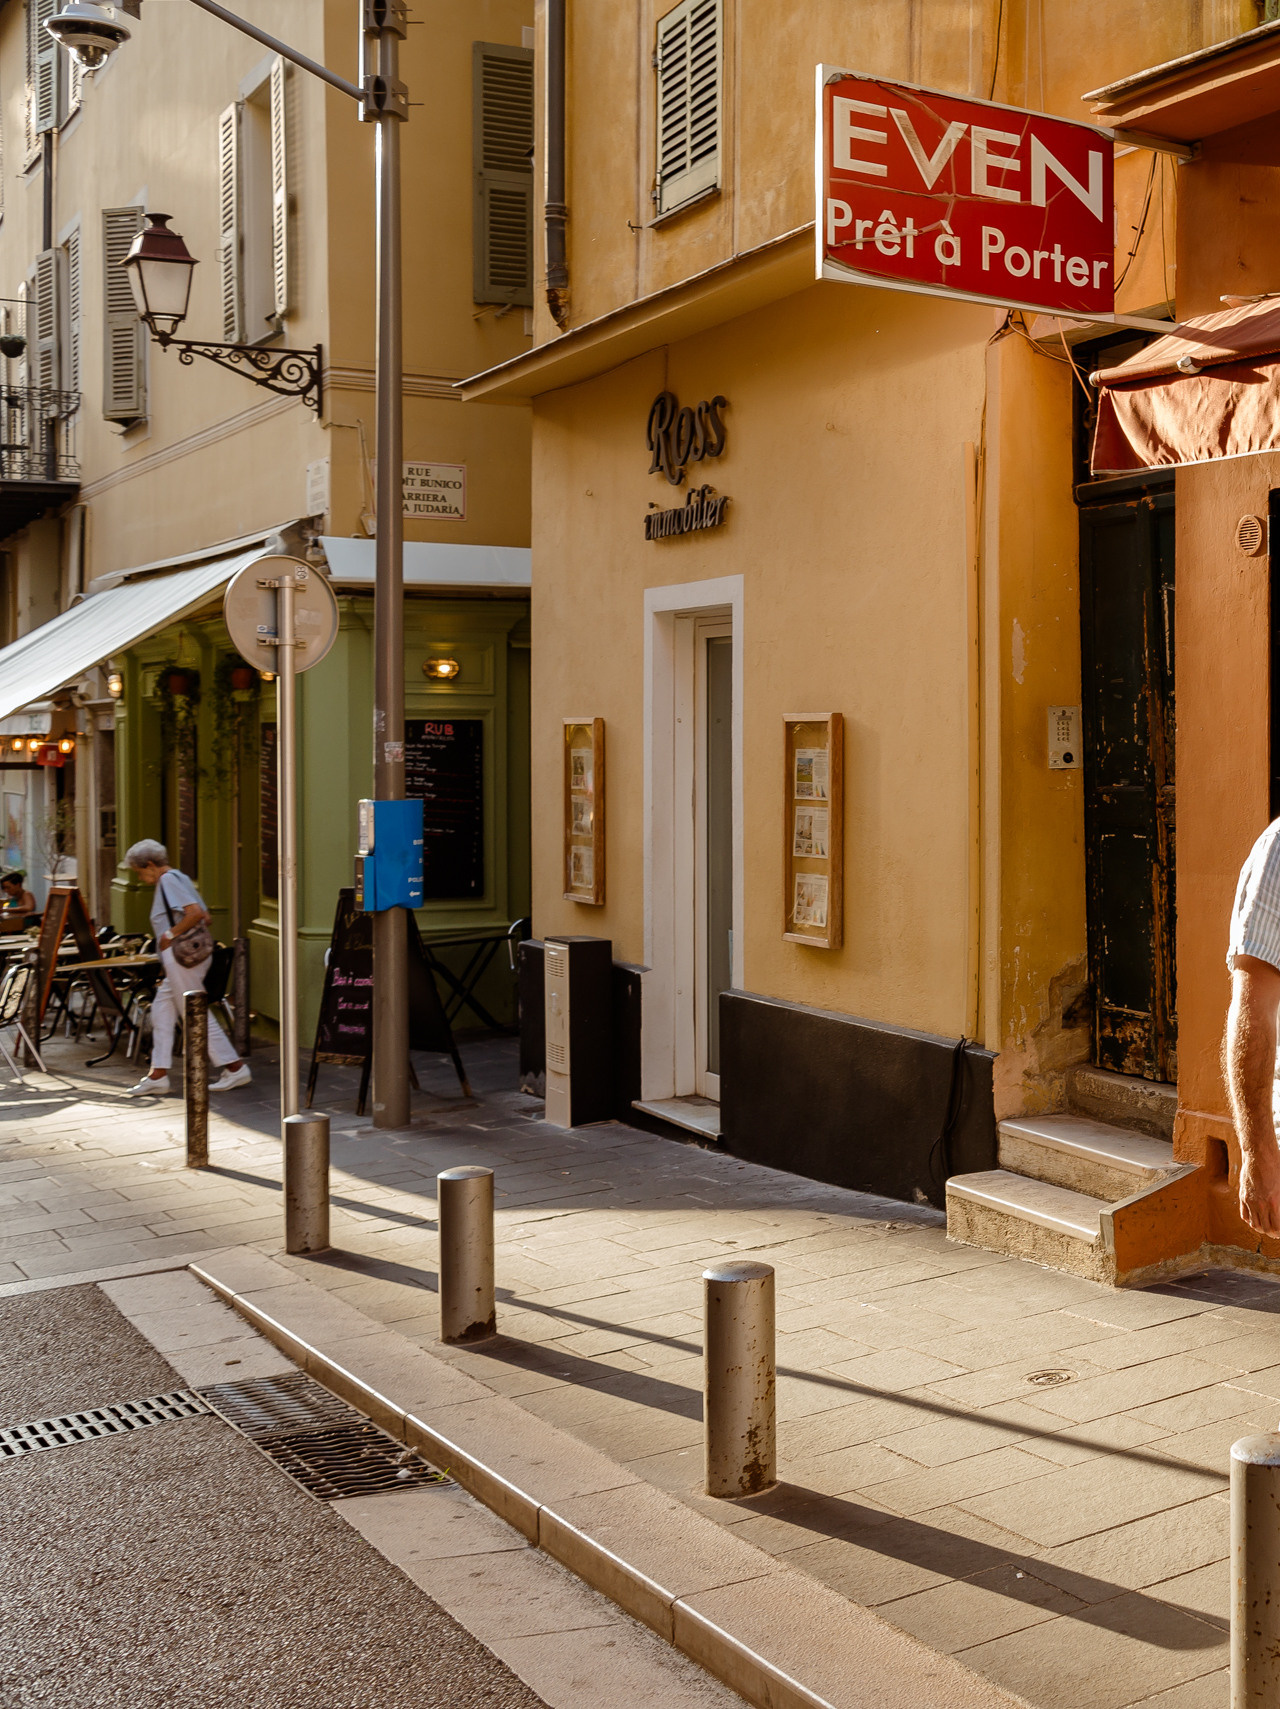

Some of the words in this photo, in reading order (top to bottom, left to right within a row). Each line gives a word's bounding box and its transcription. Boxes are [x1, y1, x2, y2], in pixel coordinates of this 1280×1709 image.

[833, 95, 1103, 223] EVEN
[827, 198, 919, 258] Prêt
[934, 219, 961, 266] à
[982, 225, 1109, 289] Porter
[646, 391, 727, 486] Ross
[407, 467, 431, 477] RUE
[420, 478, 462, 490] BUNICO
[402, 492, 447, 503] ARRIERA
[644, 484, 729, 541] immobilier
[424, 722, 454, 736] RUB
